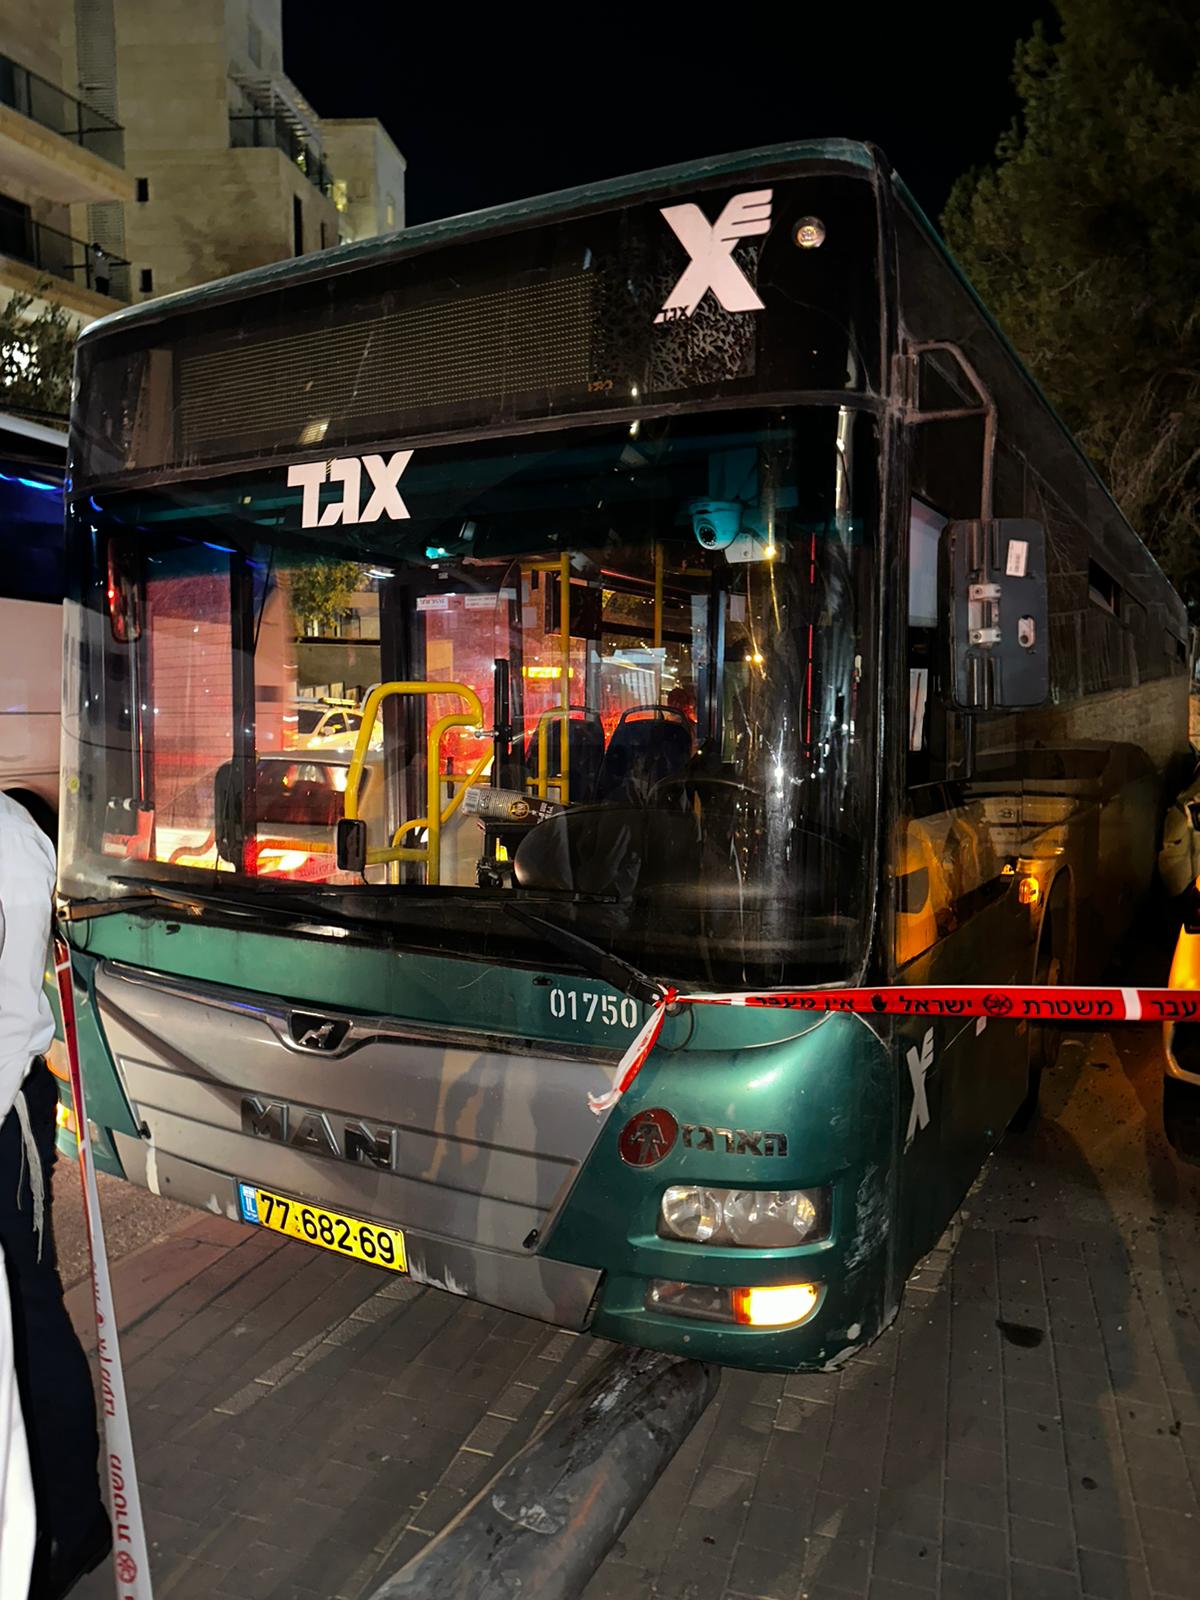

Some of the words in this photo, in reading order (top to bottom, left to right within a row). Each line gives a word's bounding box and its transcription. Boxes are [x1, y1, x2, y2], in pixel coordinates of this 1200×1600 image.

[287, 449, 415, 528] אגד
[549, 988, 638, 1029] 01750
[898, 995, 972, 1014] ישראל
[1023, 999, 1113, 1016] משטרת
[241, 1094, 399, 1171] MAN
[681, 1122, 790, 1157] הארגז
[110, 1454, 132, 1543] משטרת
